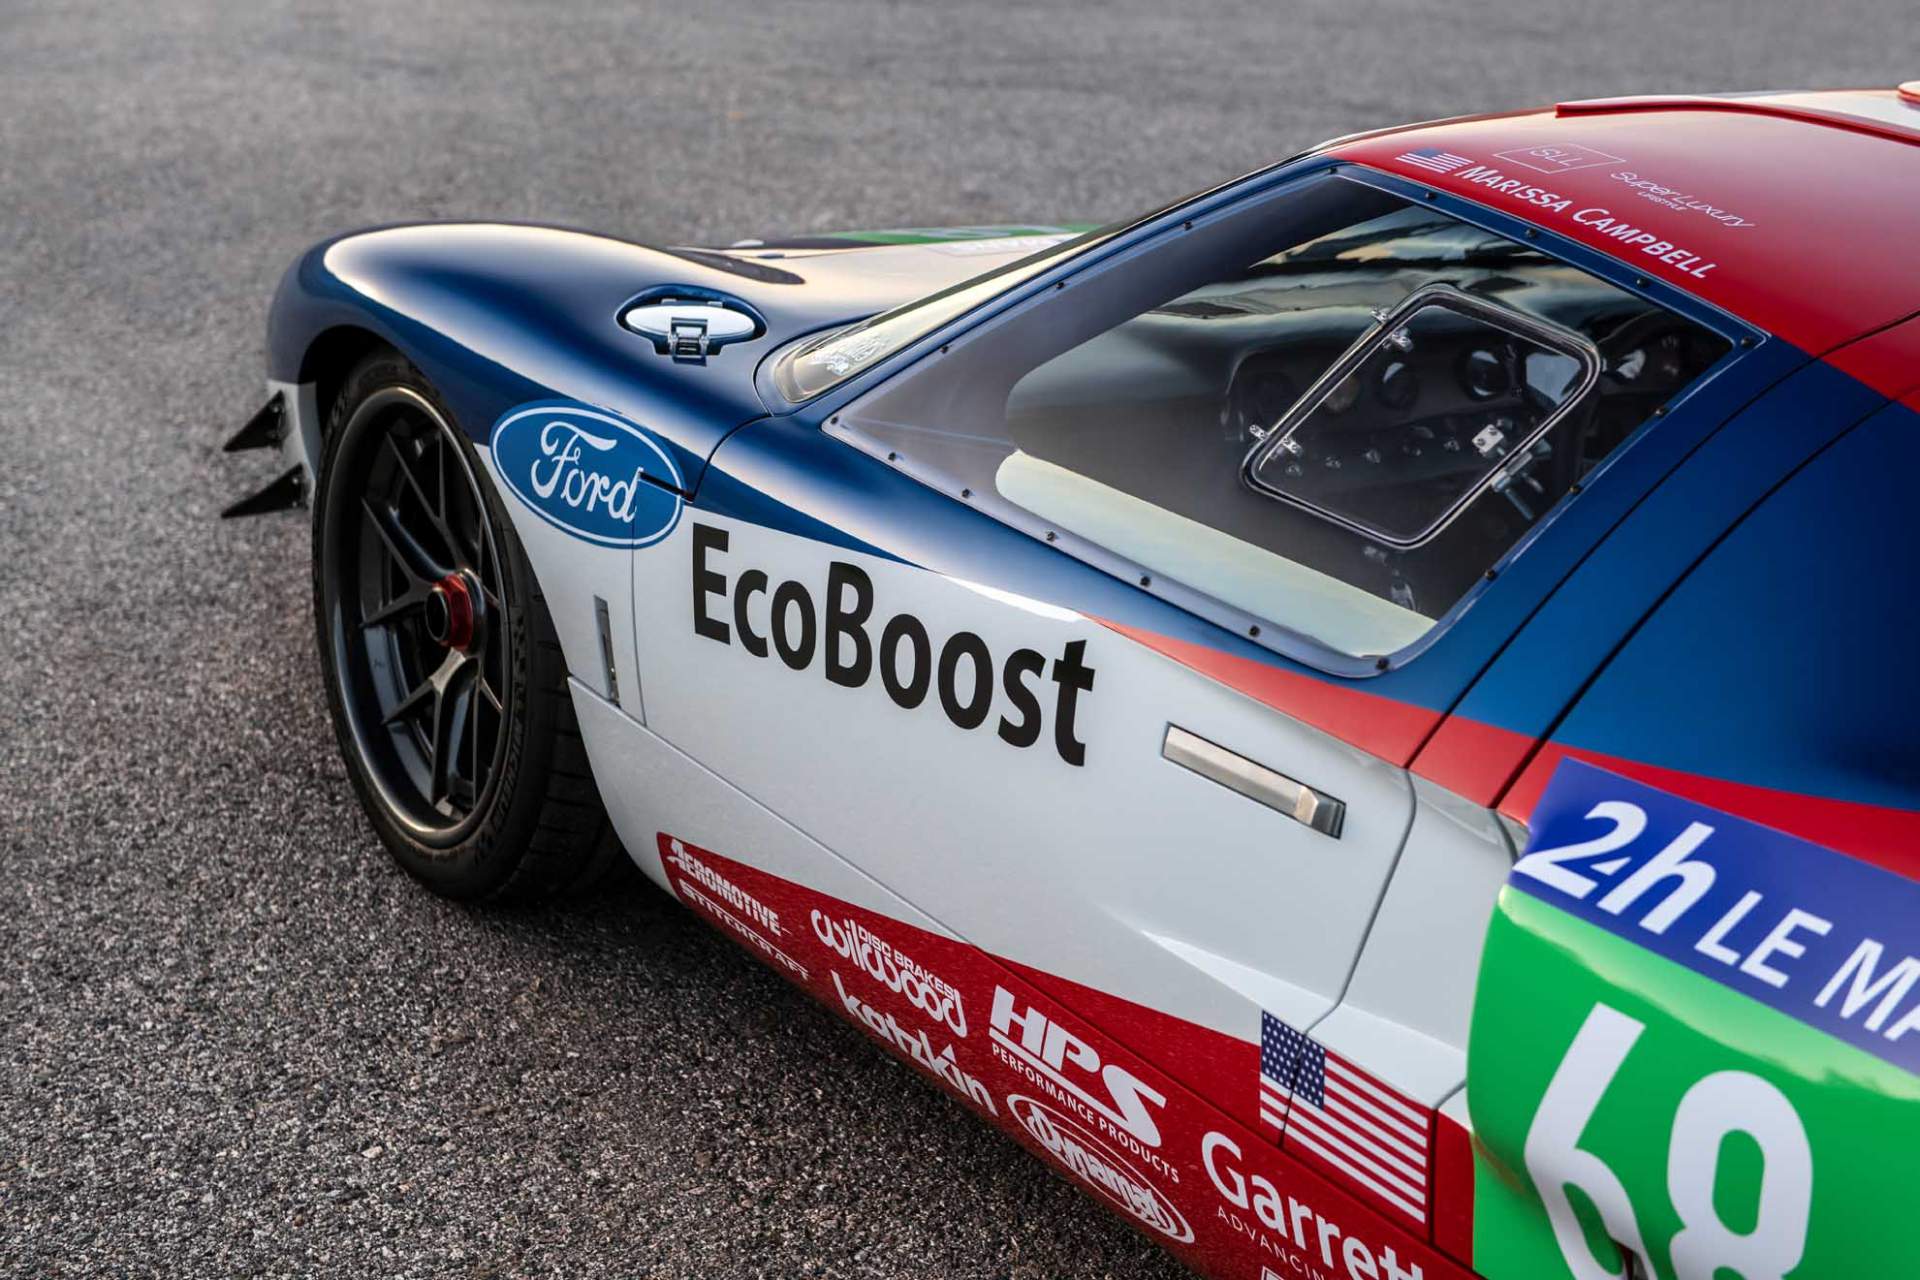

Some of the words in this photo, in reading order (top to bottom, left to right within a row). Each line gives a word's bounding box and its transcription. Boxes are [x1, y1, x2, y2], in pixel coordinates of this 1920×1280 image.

[1454, 165, 1573, 213] MARISSA
[1572, 208, 1718, 279] CAMPBELL
[1610, 171, 1681, 195] Super
[1672, 194, 1756, 227] Luxury
[530, 420, 643, 523] Ford
[693, 521, 1096, 768] EcoBoost
[666, 838, 784, 938] AEROMOTIVE
[1694, 889, 1834, 989] LE
[810, 908, 968, 1039] wilwood
[857, 924, 892, 958] DISC
[893, 948, 956, 1001] BRAKES
[830, 968, 1000, 1118] katzkin
[989, 983, 1168, 1148] HPS
[991, 1041, 1095, 1125] PERFORMANCE
[1098, 1116, 1180, 1184] PRODUCTS
[1524, 1000, 1814, 1280] 68
[1201, 1130, 1424, 1280] Garret
